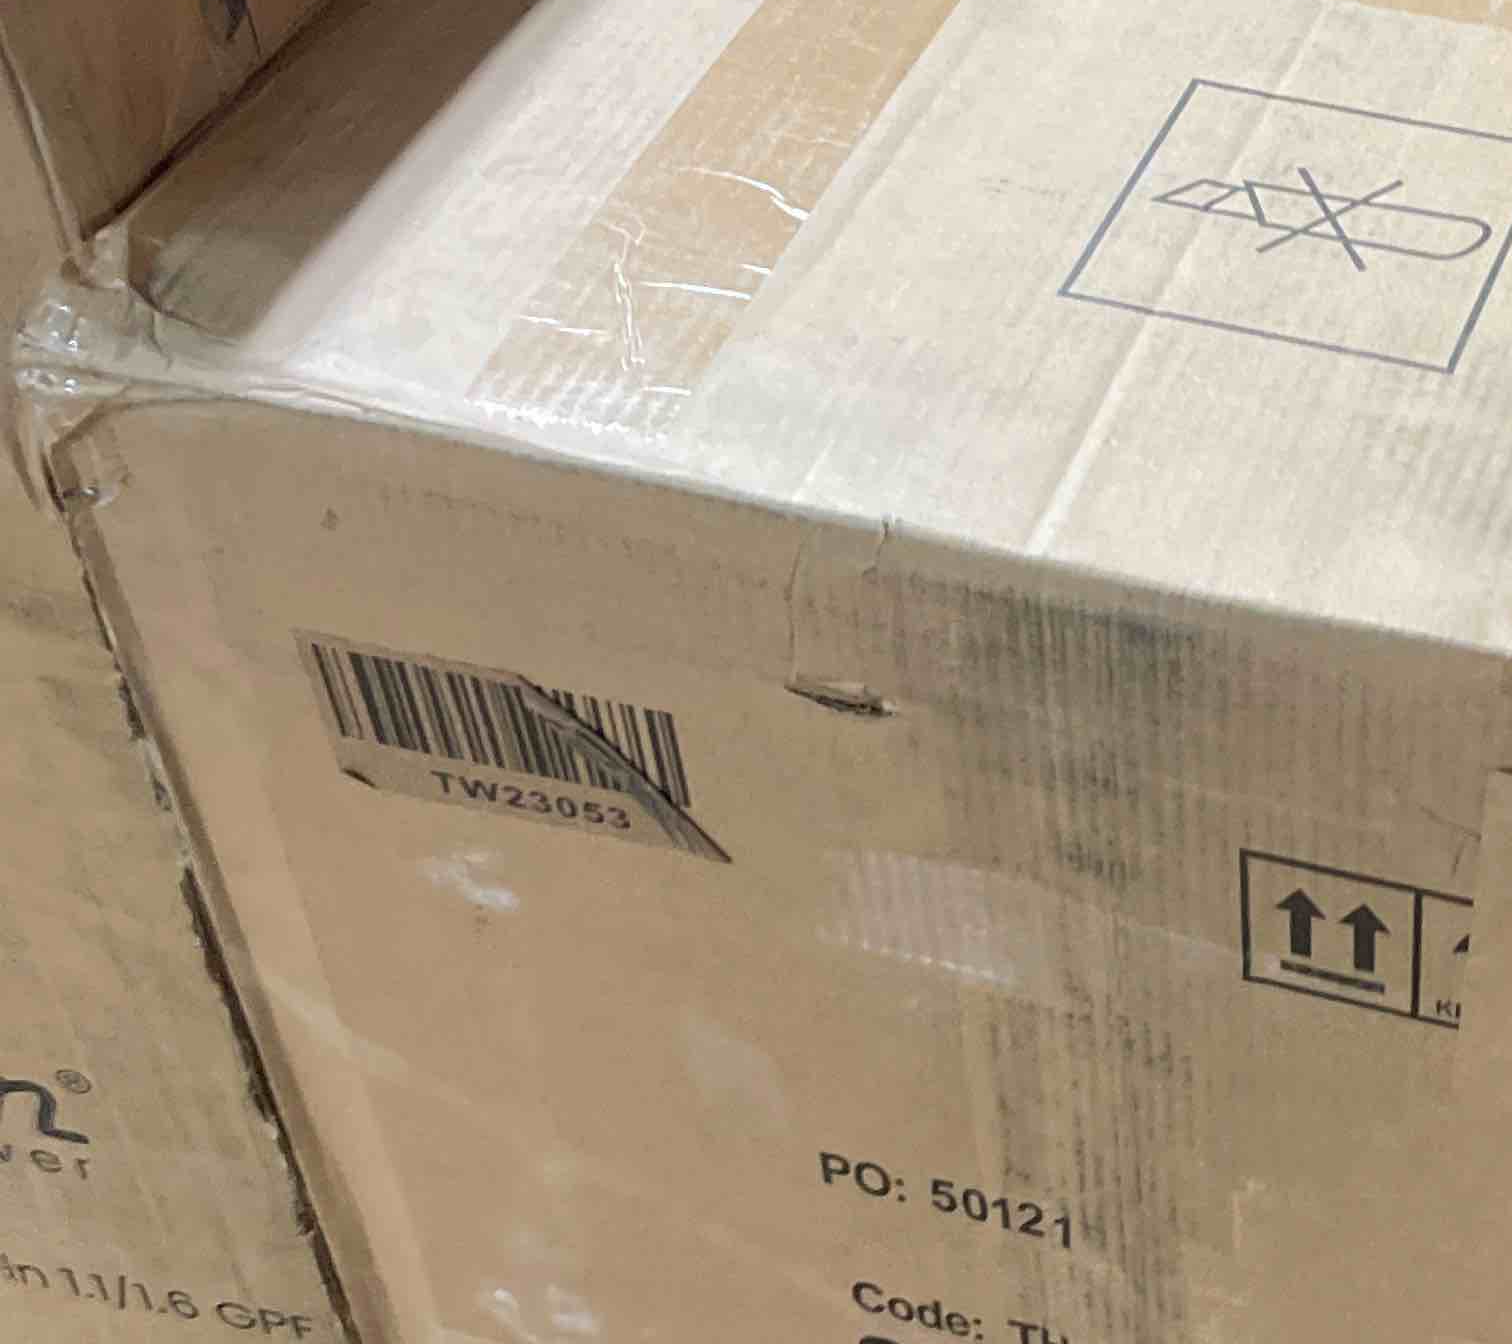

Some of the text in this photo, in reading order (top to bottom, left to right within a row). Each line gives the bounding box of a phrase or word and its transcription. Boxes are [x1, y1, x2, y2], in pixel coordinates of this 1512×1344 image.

[431, 770, 632, 831] TW23053
[819, 1152, 1073, 1249] PO: 50121
[215, 1301, 313, 1340] GPF
[852, 1281, 984, 1343] Code:
